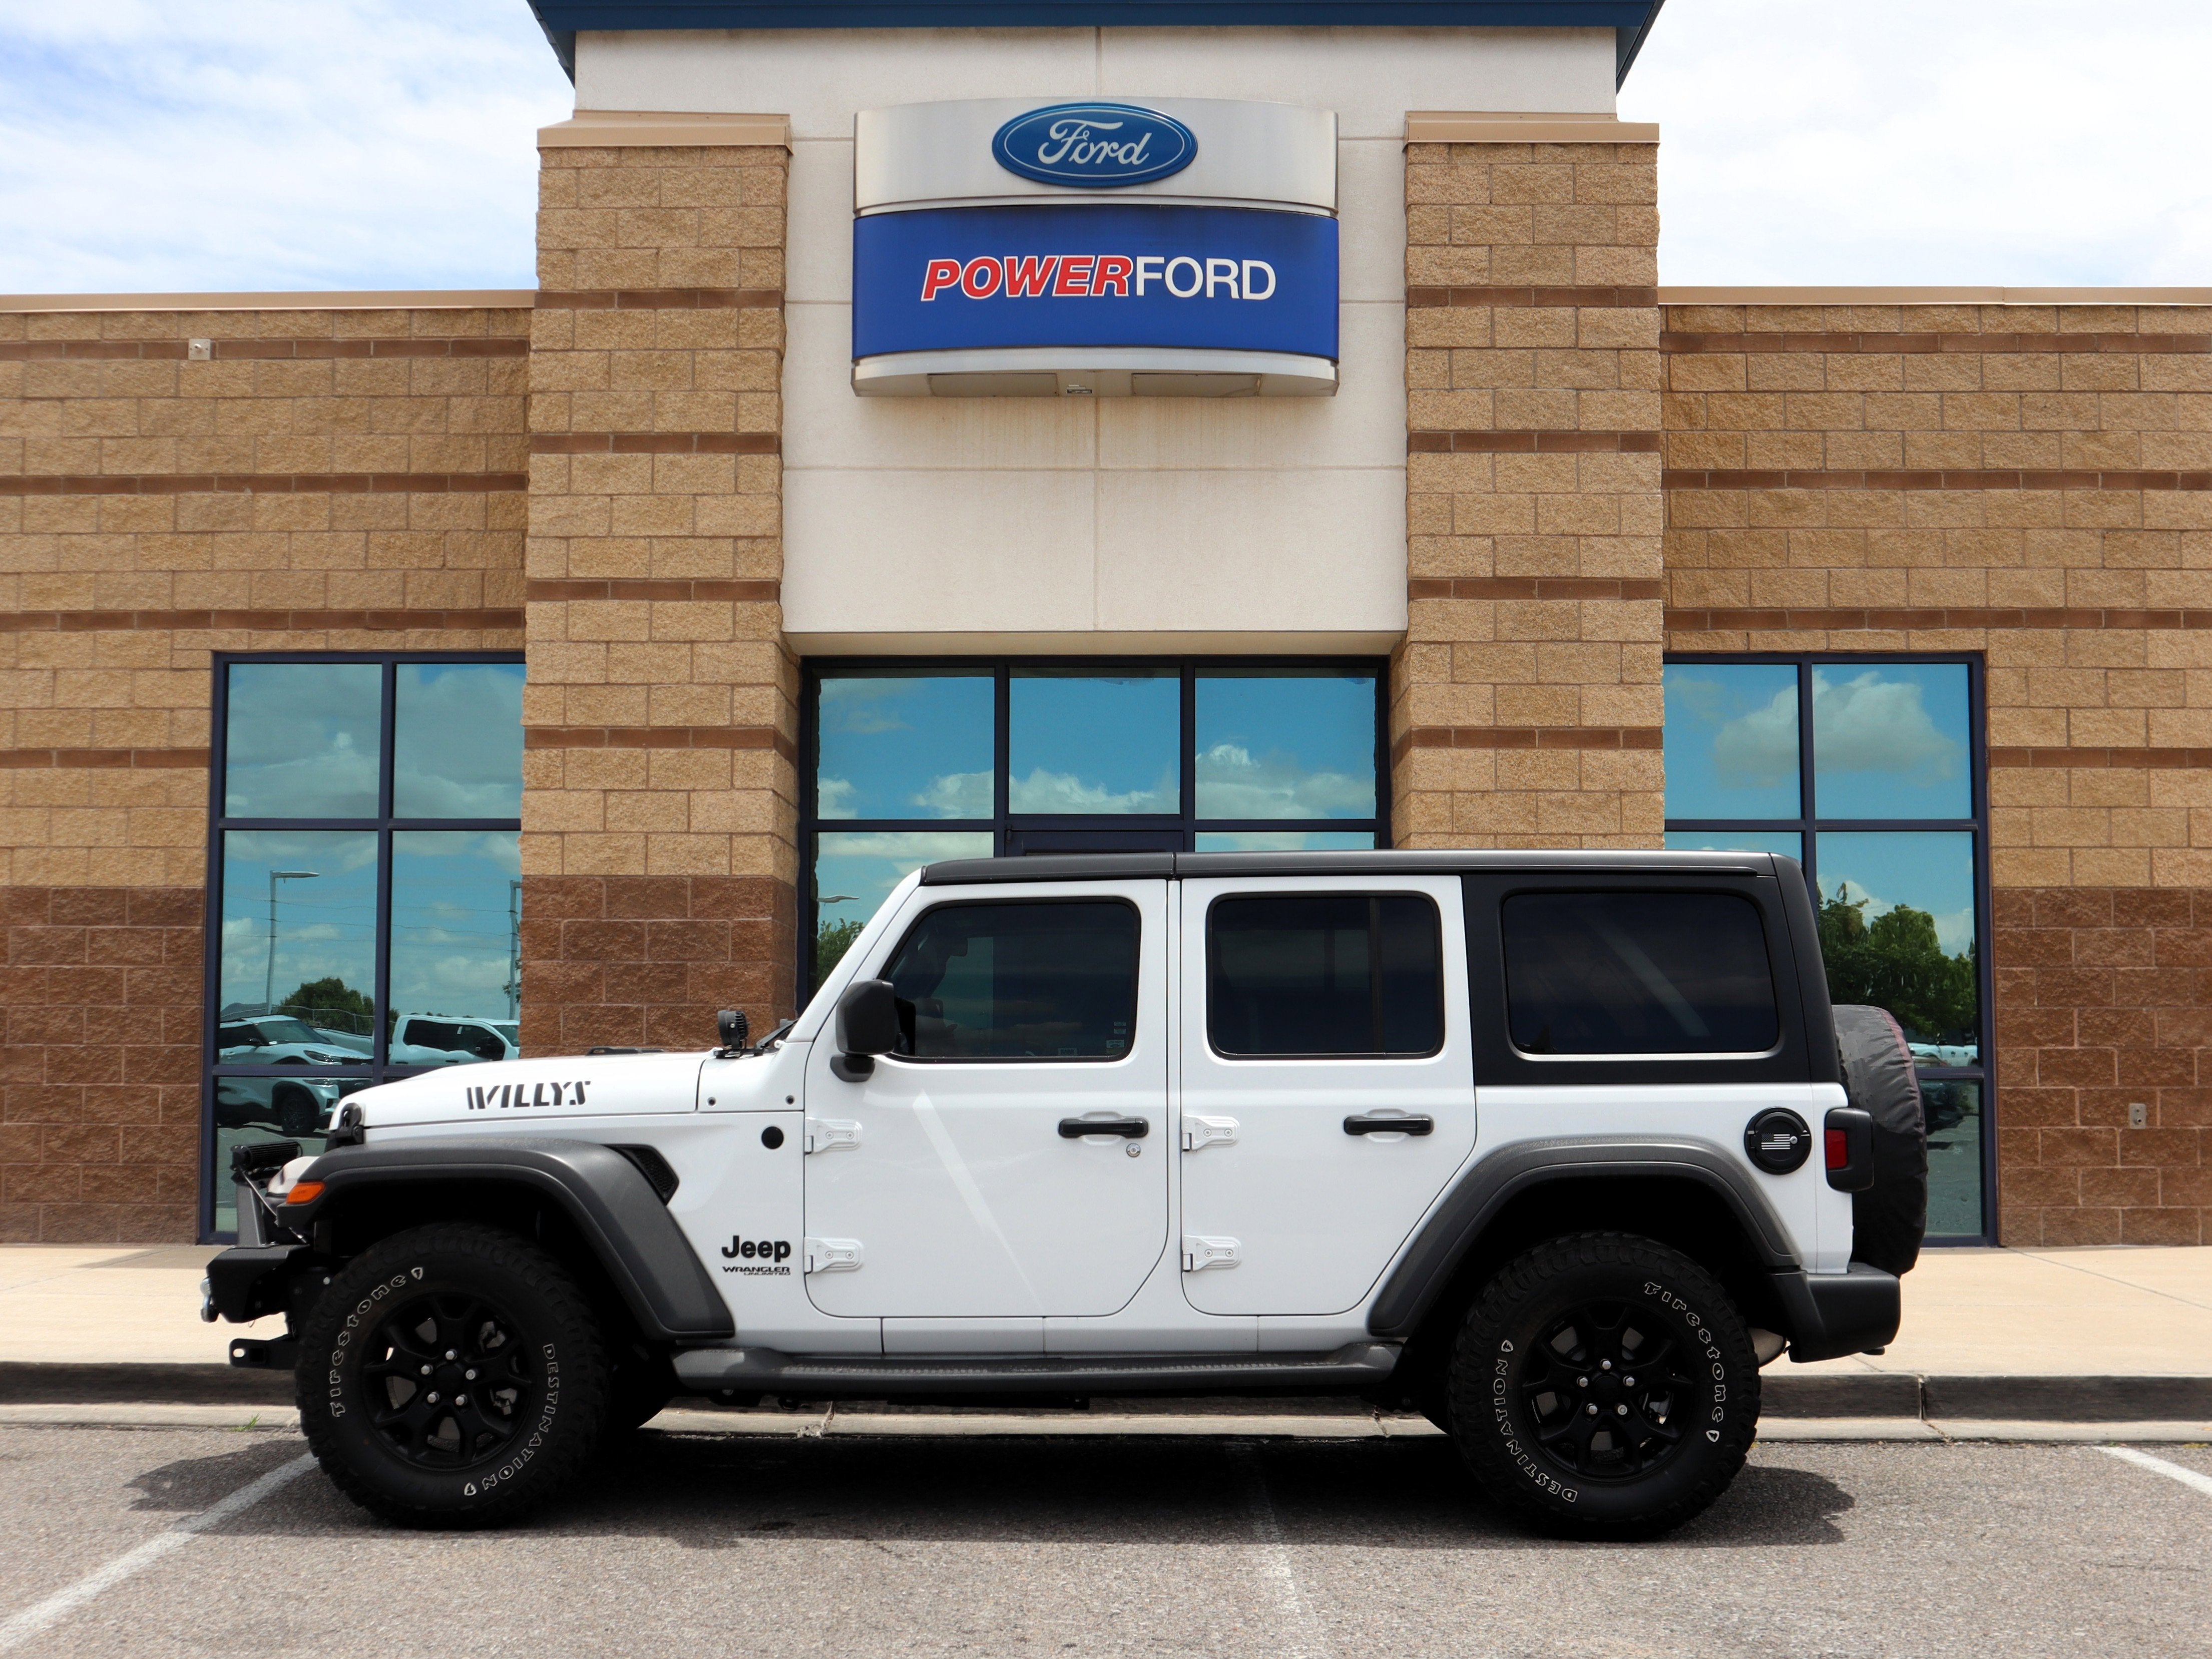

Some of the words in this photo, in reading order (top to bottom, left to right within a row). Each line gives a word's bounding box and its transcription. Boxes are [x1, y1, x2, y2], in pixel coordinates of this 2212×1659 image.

[1038, 119, 1152, 165] Ford
[467, 1080, 591, 1110] WILLYS
[721, 1235, 791, 1263] Jeep
[481, 1343, 560, 1491] DESTINATION
[1493, 1359, 1578, 1503] DESTINATION
